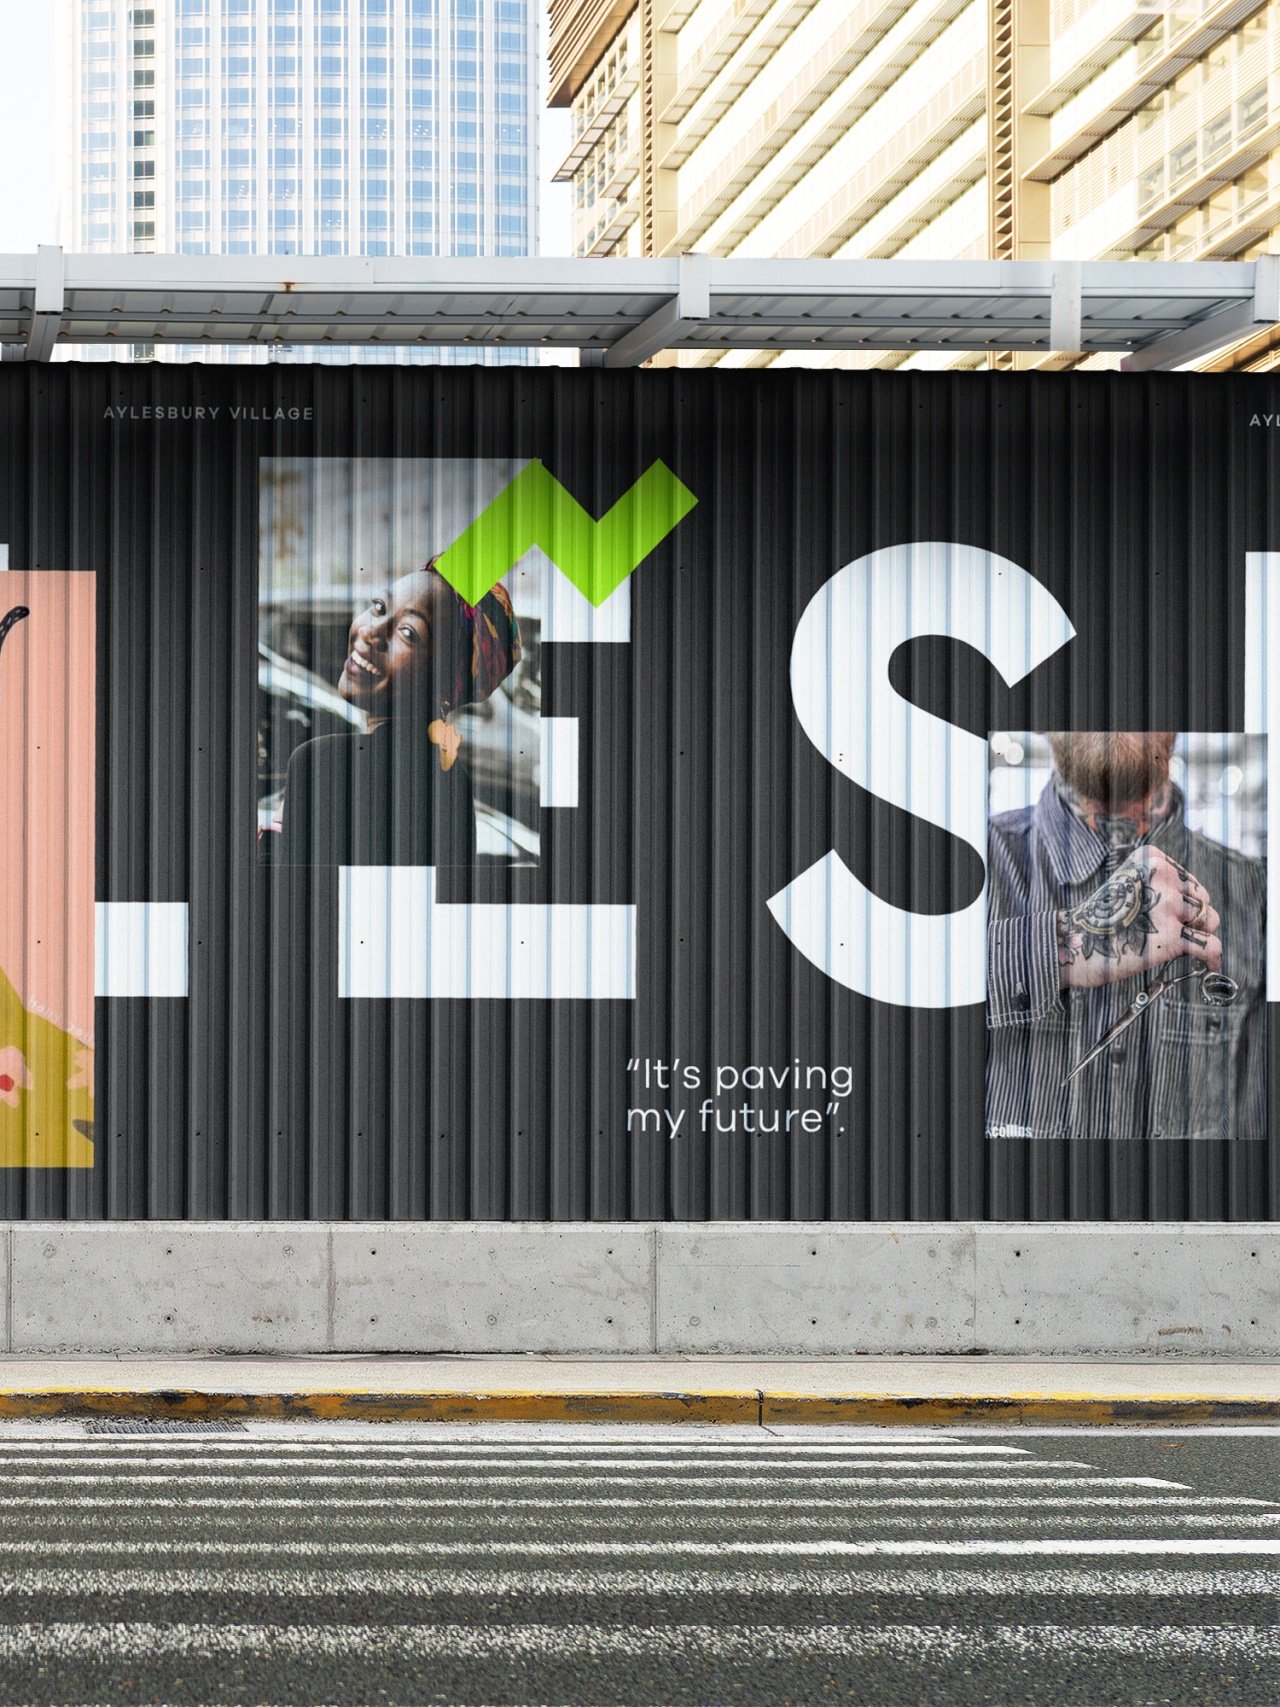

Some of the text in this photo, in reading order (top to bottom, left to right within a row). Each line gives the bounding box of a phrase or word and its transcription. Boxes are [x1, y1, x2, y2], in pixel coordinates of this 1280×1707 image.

[103, 406, 314, 421] AYLESBURY VILLAGE
[716, 1058, 853, 1098] paving
[627, 1108, 686, 1140] my
